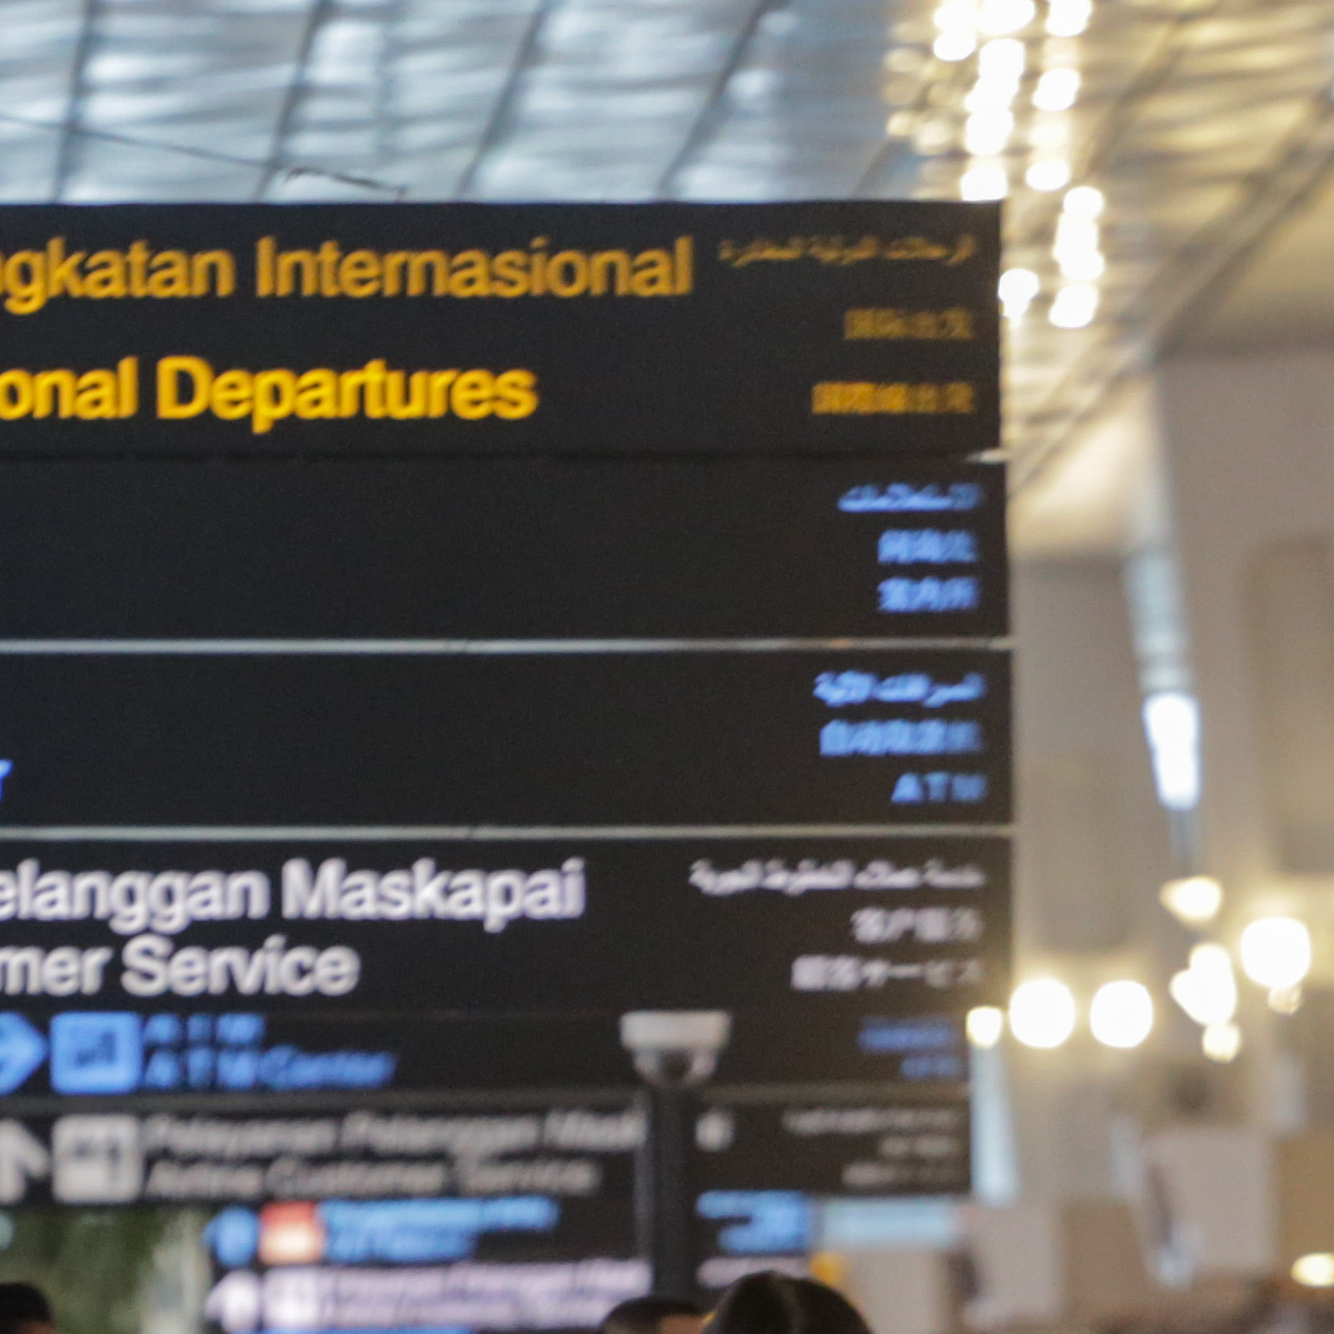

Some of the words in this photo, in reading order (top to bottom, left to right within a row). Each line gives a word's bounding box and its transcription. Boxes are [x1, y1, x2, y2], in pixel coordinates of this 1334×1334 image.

[255, 232, 692, 298] Internasional
[155, 356, 539, 435] Departures
[280, 857, 587, 934] Maskapai
[120, 934, 361, 997] Service
